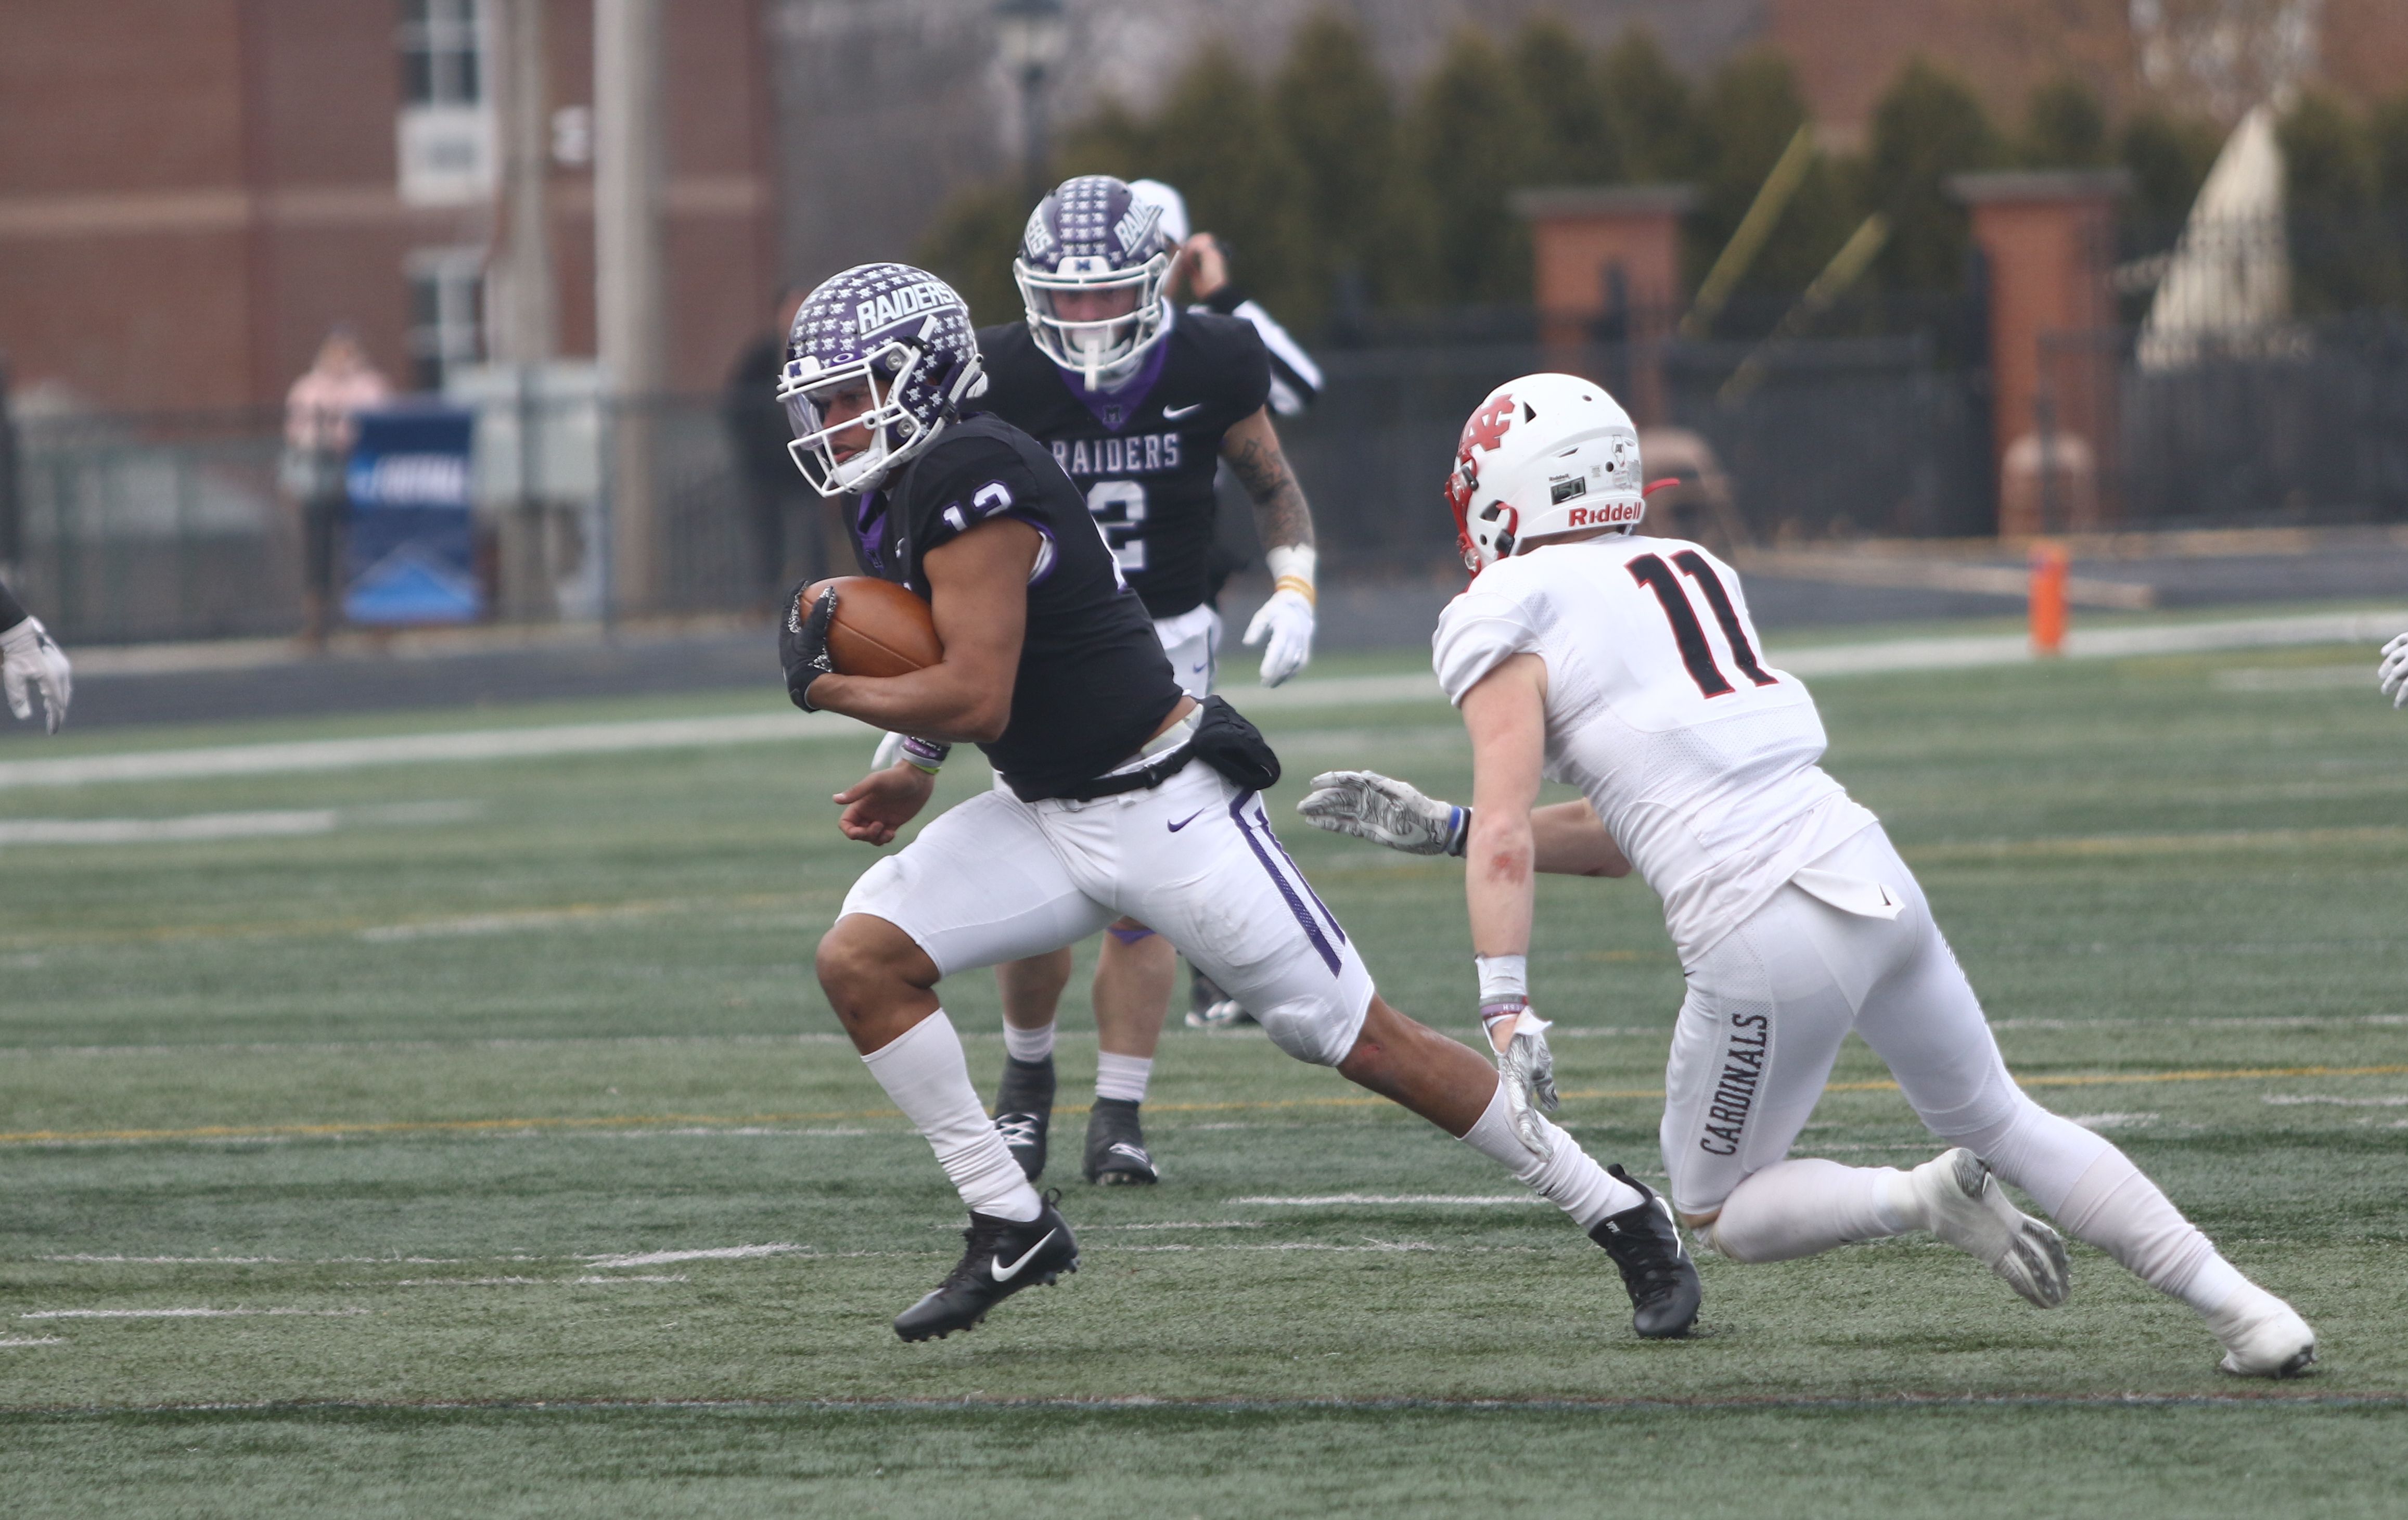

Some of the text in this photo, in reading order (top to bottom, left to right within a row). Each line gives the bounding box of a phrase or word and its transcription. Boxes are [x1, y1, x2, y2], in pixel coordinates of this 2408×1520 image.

[856, 282, 955, 334] RAIDERS
[1051, 433, 1179, 473] RAIDERS
[1086, 479, 1145, 570] 2
[1568, 501, 1642, 527] Riddell
[1623, 548, 1781, 699] 11
[1700, 1013, 1767, 1156] CARDINALS
